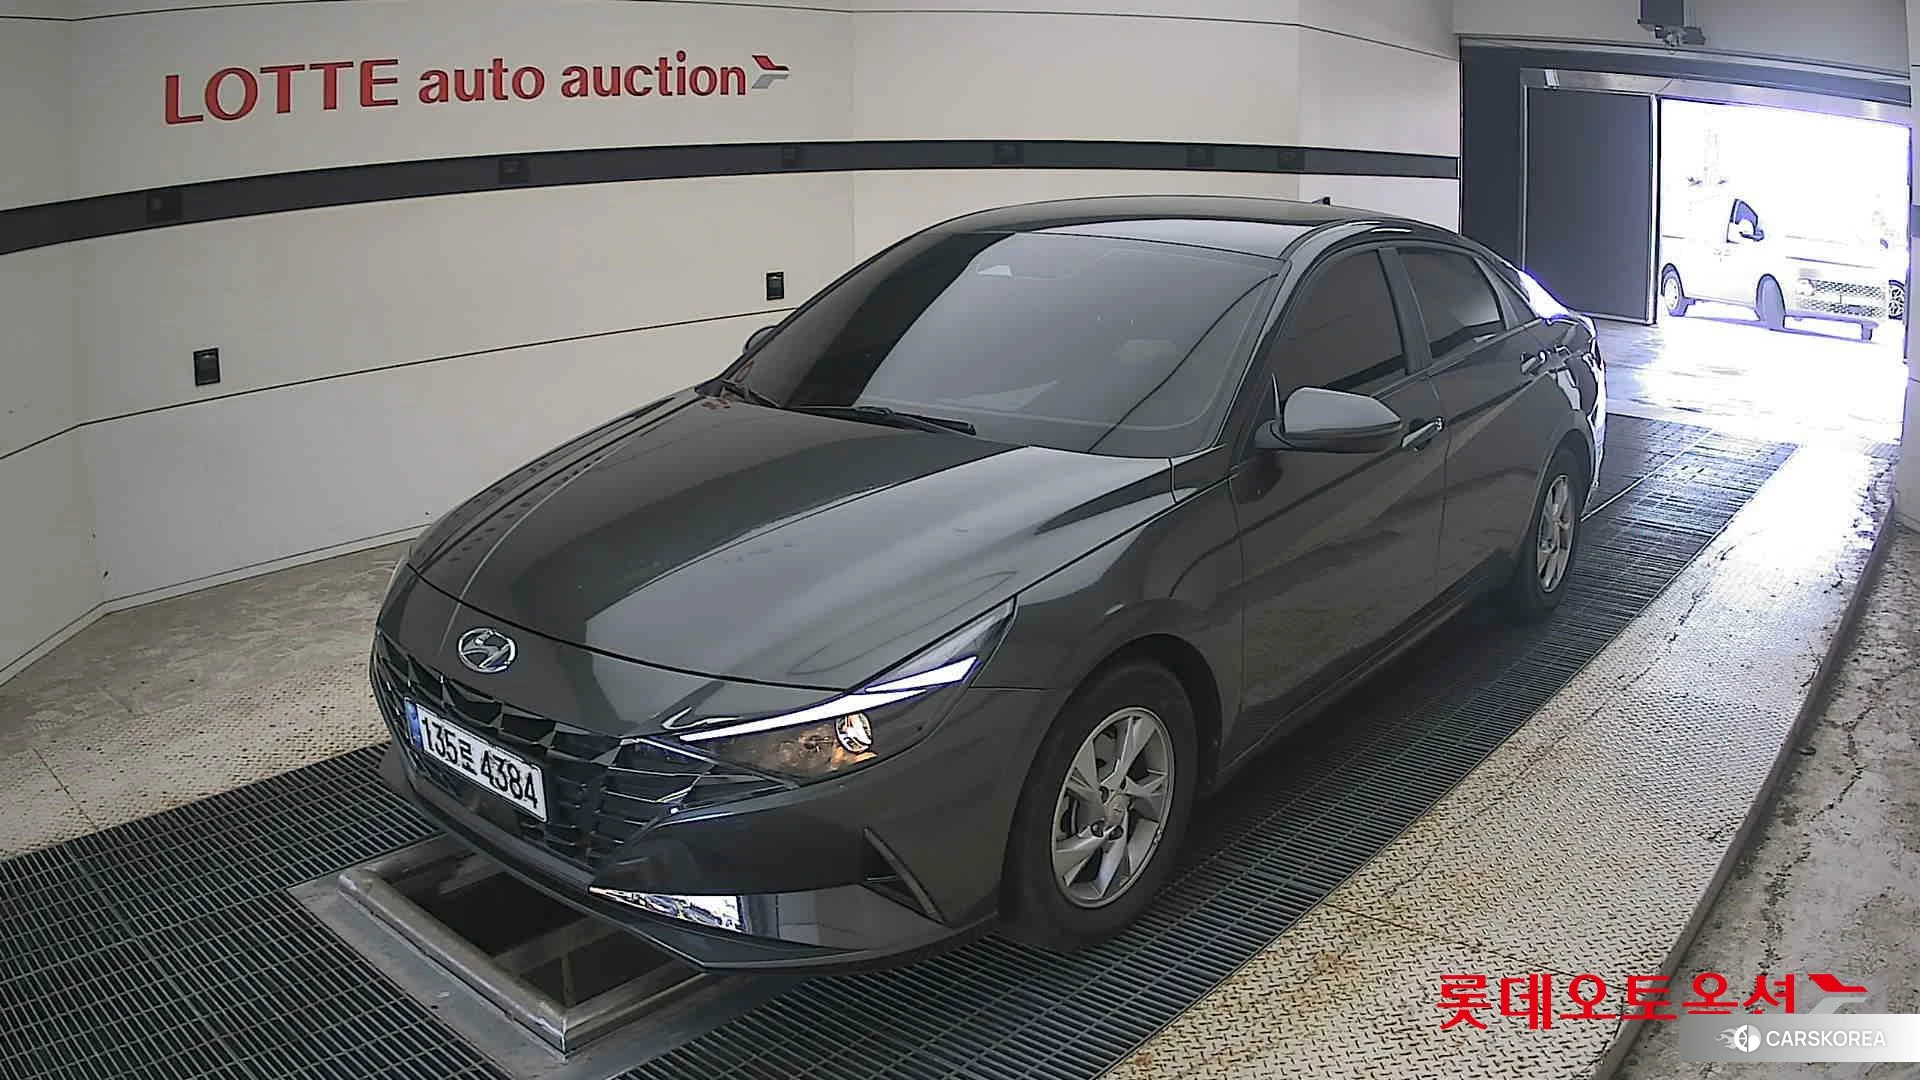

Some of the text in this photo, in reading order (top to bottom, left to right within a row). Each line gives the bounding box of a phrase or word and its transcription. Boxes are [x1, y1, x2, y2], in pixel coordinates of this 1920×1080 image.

[164, 50, 748, 125] LOTTE auto auction
[480, 750, 539, 809] 4384
